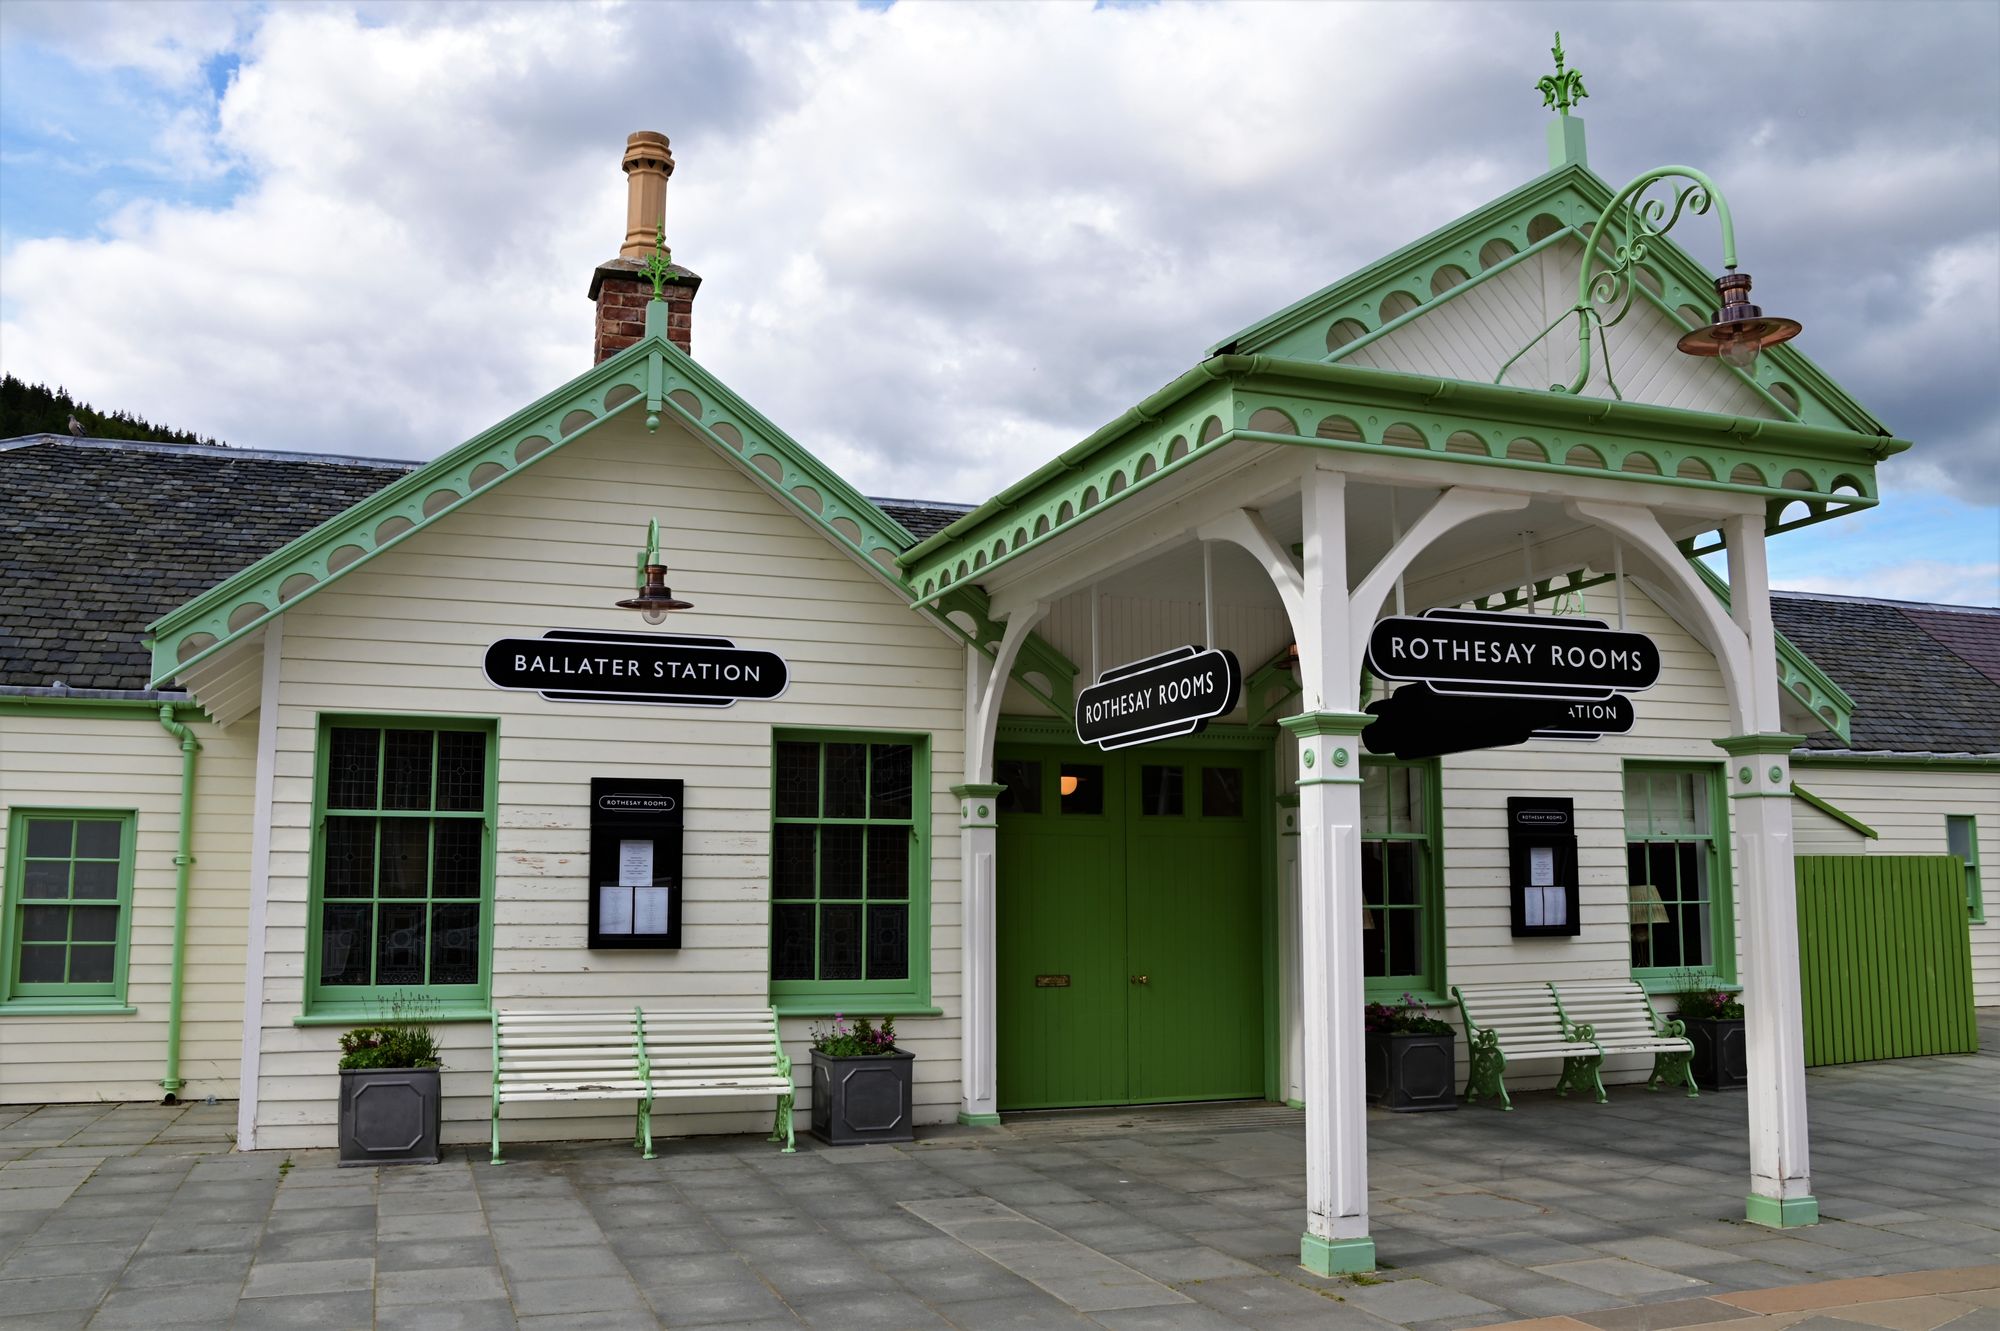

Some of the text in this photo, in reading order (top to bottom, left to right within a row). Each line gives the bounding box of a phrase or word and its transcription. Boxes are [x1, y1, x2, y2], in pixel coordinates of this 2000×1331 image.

[514, 654, 760, 682] BALLATER STATION
[1391, 636, 1642, 672] ROTHESAY ROOMS
[1085, 670, 1214, 725] ROTHESAY ROOMS
